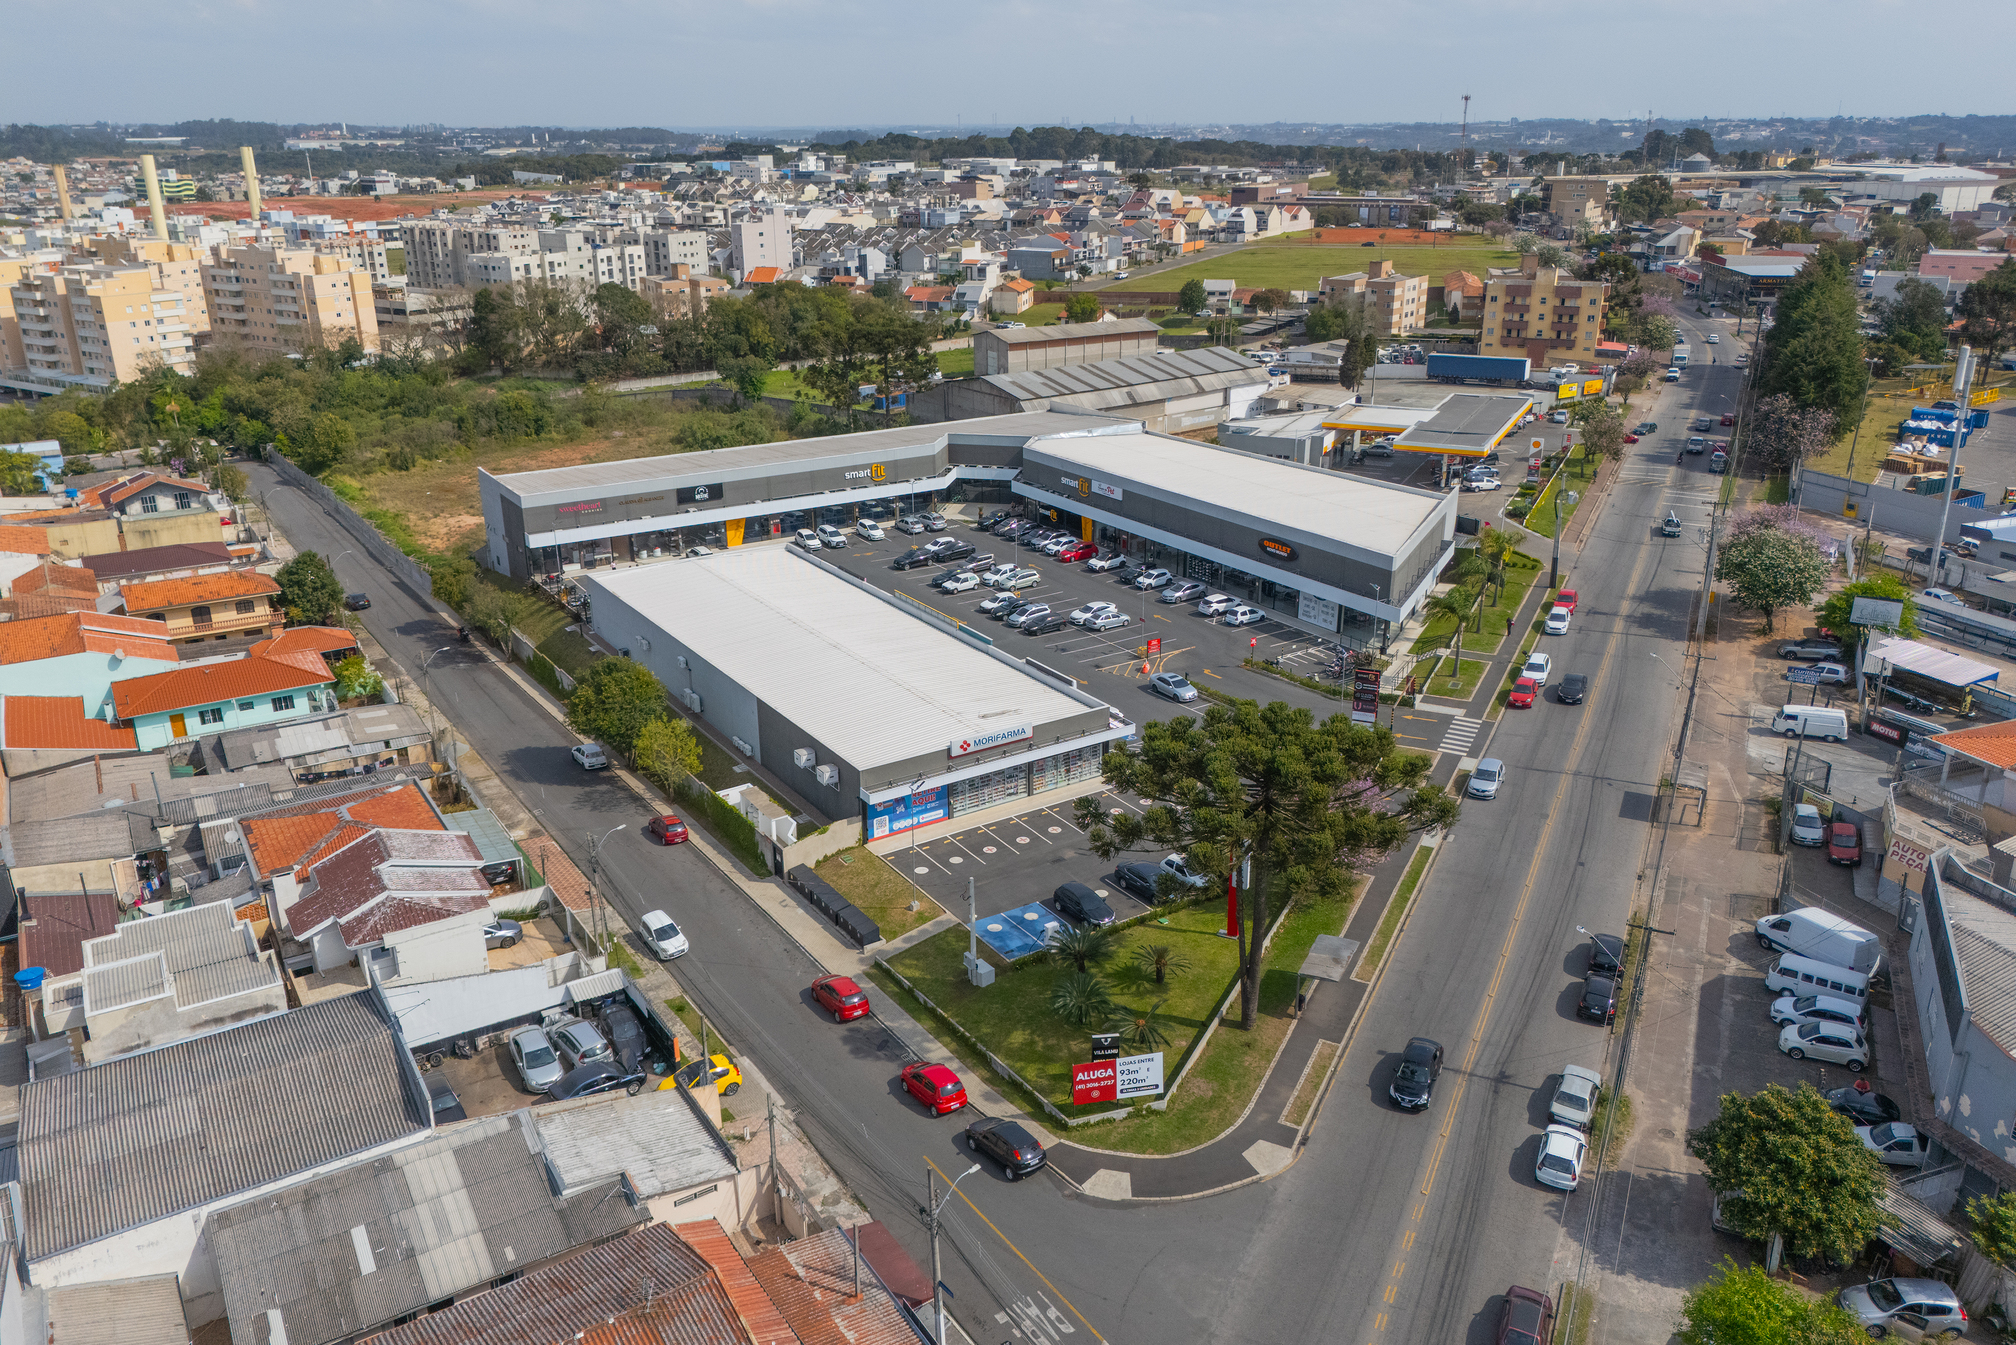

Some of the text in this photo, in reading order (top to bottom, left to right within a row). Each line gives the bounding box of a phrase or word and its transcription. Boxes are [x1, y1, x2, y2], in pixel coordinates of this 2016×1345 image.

[845, 464, 887, 480] smart fit
[1061, 476, 1079, 489] smart
[1079, 478, 1089, 494] fit
[559, 501, 601, 513] sweetheart
[1263, 540, 1291, 554] OUTLET
[974, 728, 1026, 747] MORIFARMA
[1871, 723, 1898, 739] MOTUL
[1892, 841, 1926, 860] AUTO
[1076, 1068, 1114, 1081] ALUGA
